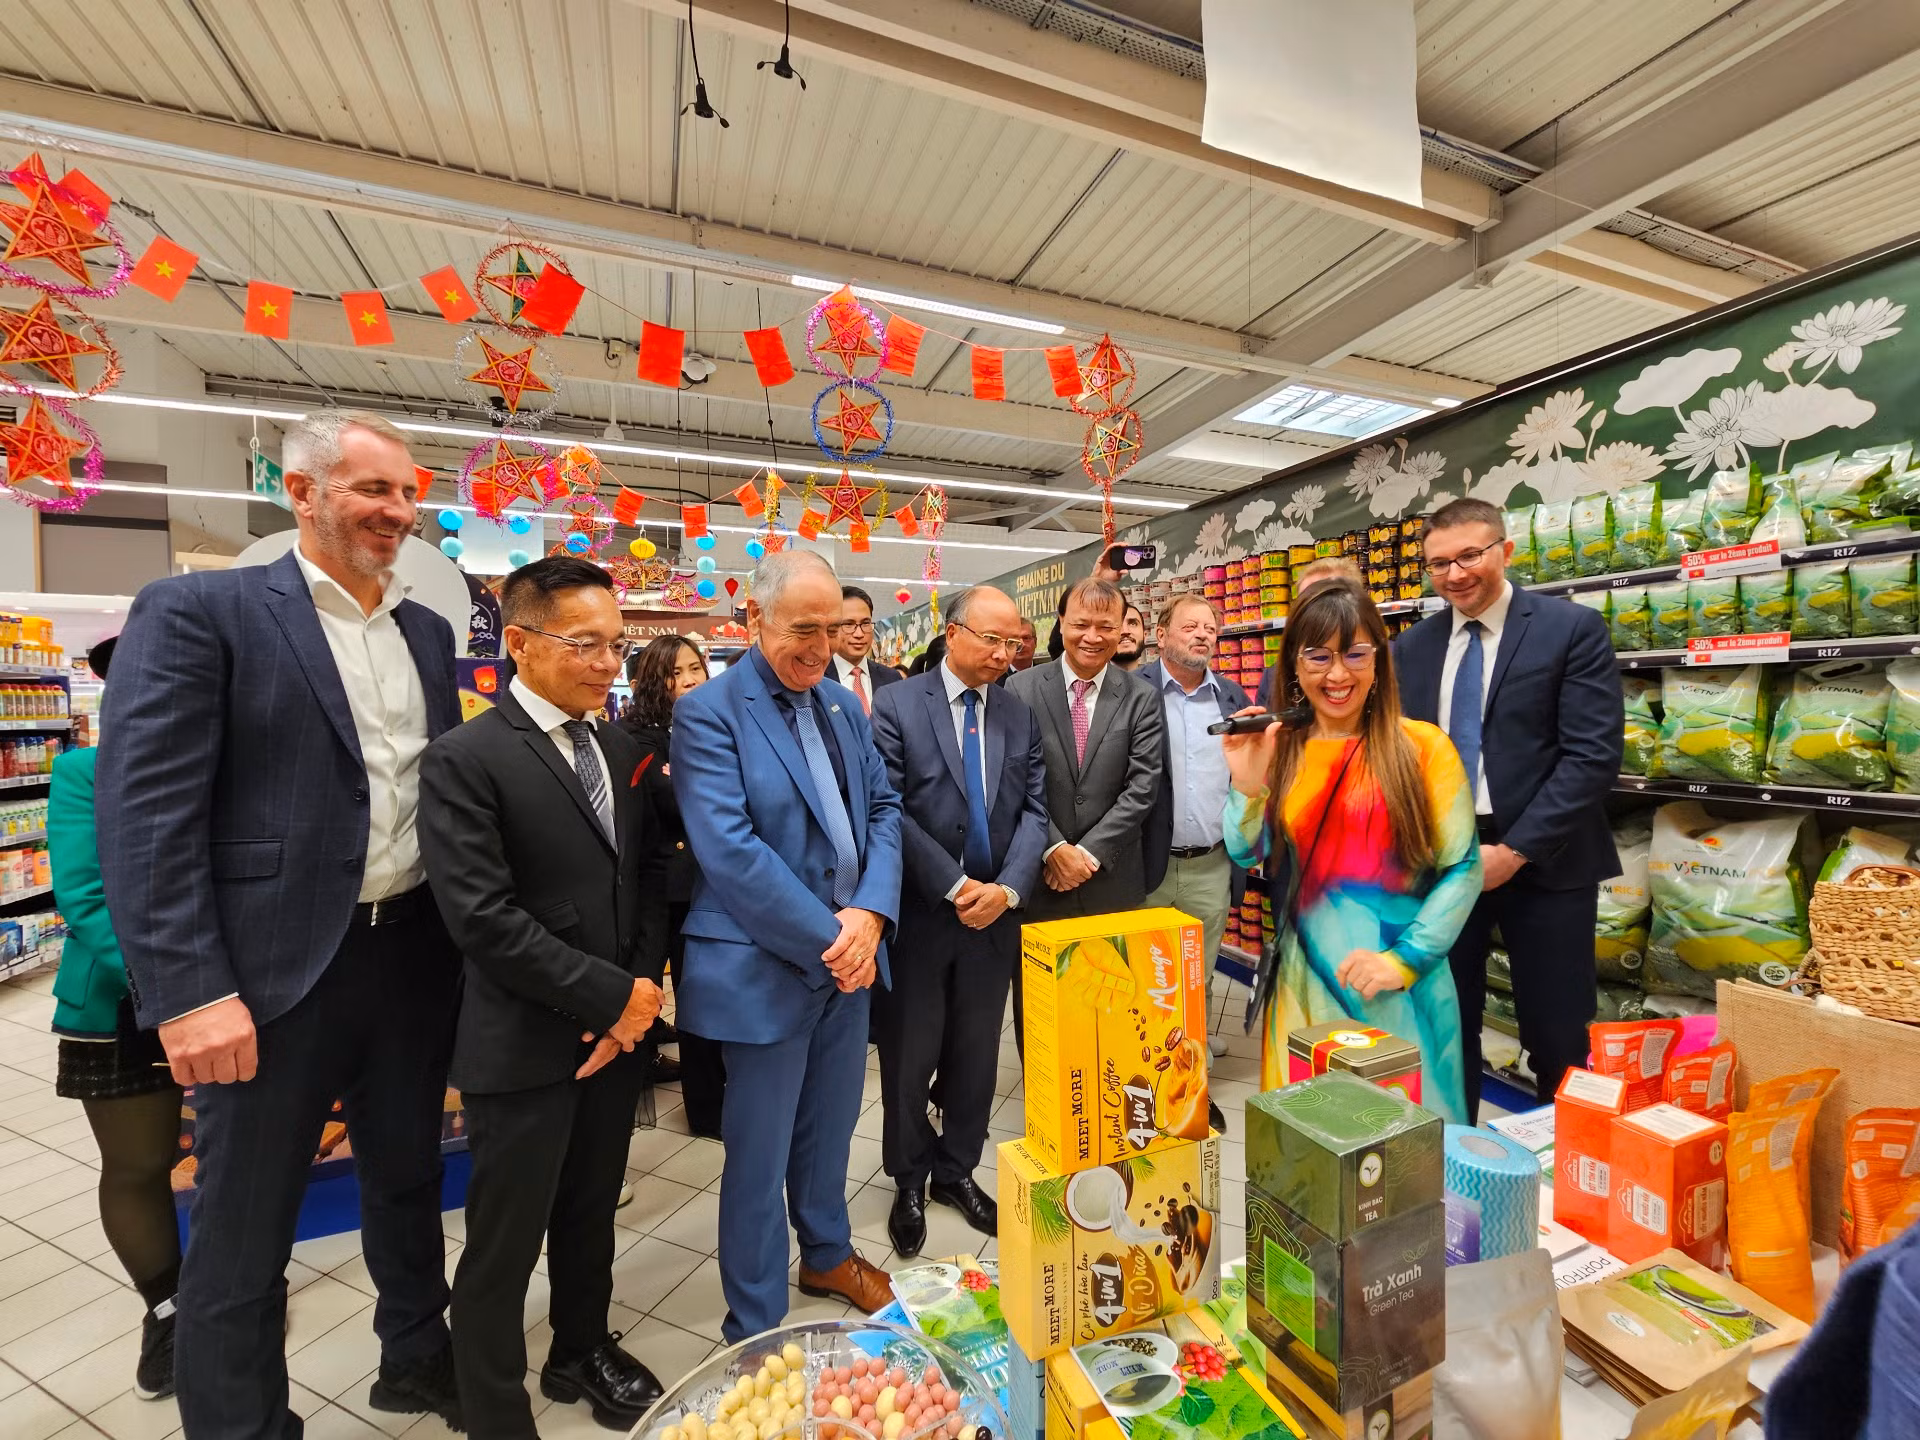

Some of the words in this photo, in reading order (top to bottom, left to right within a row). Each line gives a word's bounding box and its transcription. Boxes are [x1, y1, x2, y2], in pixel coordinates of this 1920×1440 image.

[1684, 554, 1706, 566] -50%
[1710, 553, 1719, 562] sur
[1721, 551, 1727, 559] le
[1727, 549, 1746, 558] 2ème
[1747, 544, 1773, 556] produit
[1833, 546, 1857, 557] RIZ
[1016, 567, 1049, 593] SEMAINE
[1051, 561, 1065, 582] DU
[1613, 578, 1629, 587] RIZ
[649, 627, 677, 636] NAM
[1692, 639, 1714, 650] -50%
[1717, 640, 1728, 648] sur
[1729, 639, 1736, 647] le
[1737, 638, 1755, 646] 2ème
[1757, 636, 1783, 646] produit
[1818, 648, 1841, 657] RIZ
[1856, 765, 1864, 776] 5
[1688, 785, 1708, 793] RIZ
[1827, 796, 1851, 806] RIZ
[1184, 940, 1194, 960] 270
[1147, 944, 1178, 1011] Mango
[1071, 1069, 1082, 1116] MORE
[1103, 1057, 1121, 1108] Coffee
[1079, 1118, 1088, 1161] MEET
[1104, 1113, 1130, 1158] Instant
[1013, 1143, 1031, 1159] MORE
[1204, 1151, 1213, 1171] 270
[1030, 1159, 1049, 1175] MEET
[1365, 1210, 1378, 1222] TEA
[1077, 1252, 1088, 1271] tan
[1362, 1280, 1382, 1302] Trà
[1387, 1264, 1422, 1291] Xanh
[1554, 1256, 1611, 1290] PORTFOLI
[1044, 1264, 1055, 1307] MORE
[1079, 1298, 1091, 1319] phê
[1370, 1296, 1397, 1316] Green
[1399, 1288, 1414, 1303] Tea
[1131, 1302, 1155, 1323] Vị
[1050, 1307, 1060, 1346] MEET
[1095, 1360, 1119, 1375] MORE
[1119, 1362, 1147, 1377] MEET
